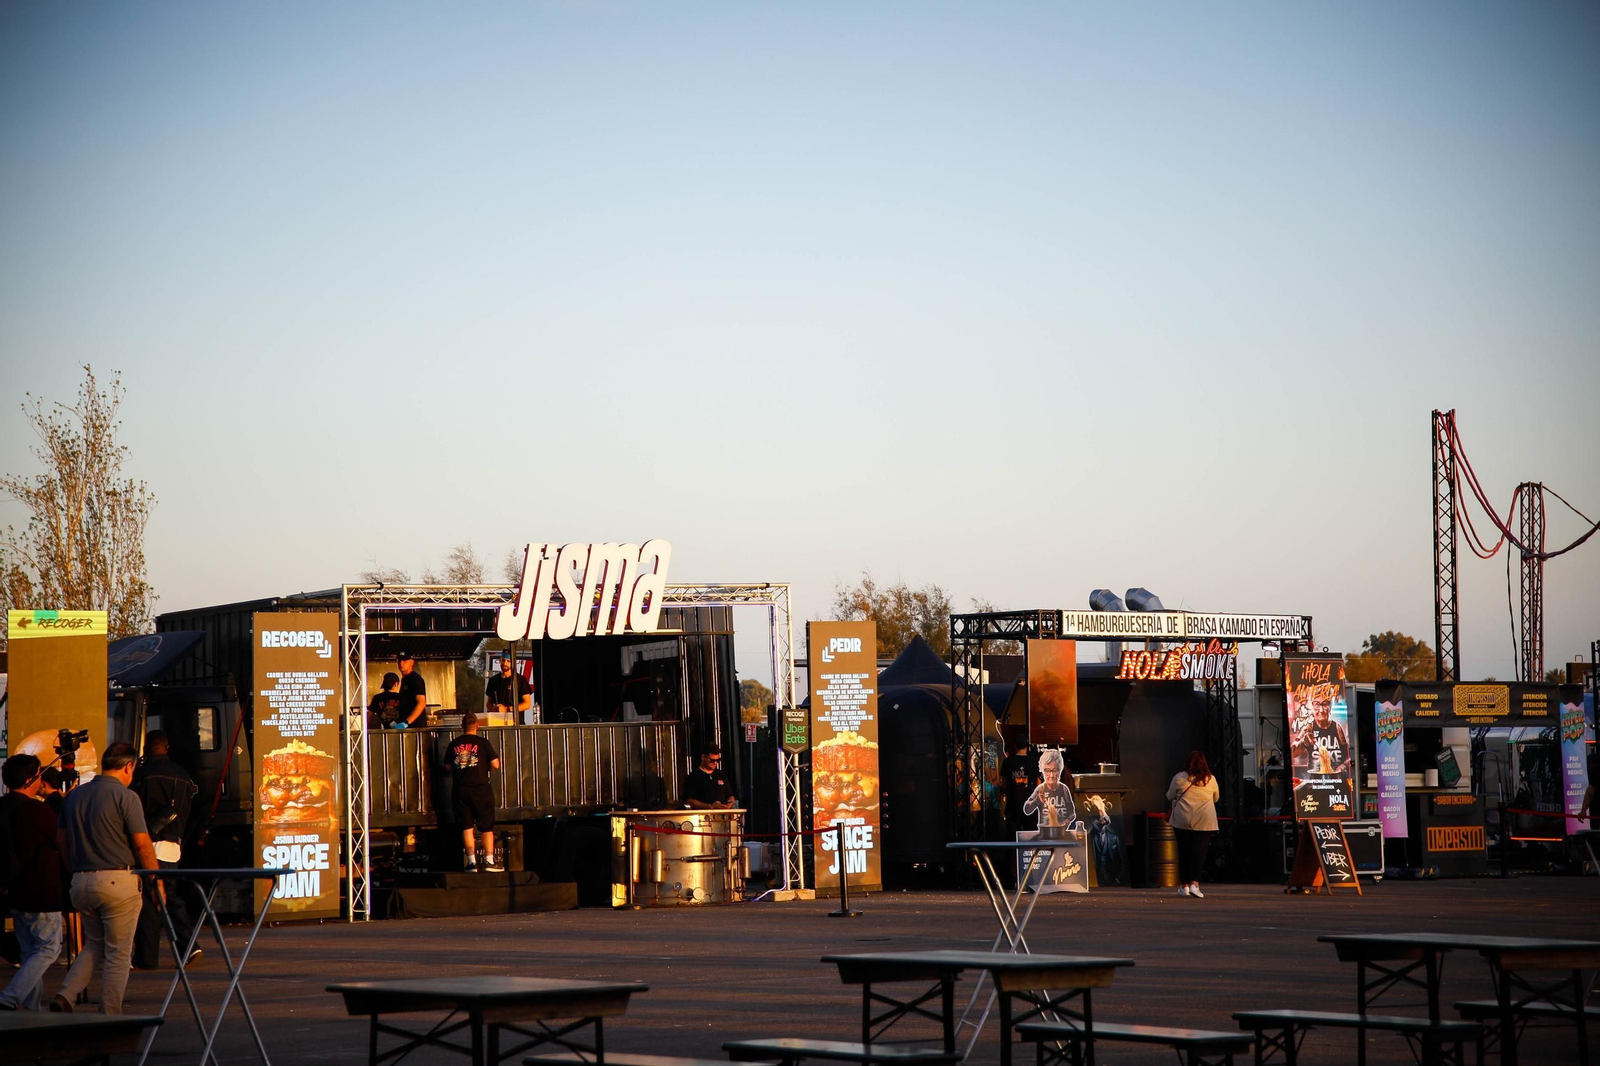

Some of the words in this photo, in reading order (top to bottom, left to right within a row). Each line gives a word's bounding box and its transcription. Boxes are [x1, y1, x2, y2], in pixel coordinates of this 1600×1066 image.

[37, 618, 93, 630] RECOGER
[1167, 616, 1178, 633] DE
[1187, 616, 1217, 634] BRASA
[1220, 618, 1257, 636] KAMADO
[1260, 618, 1269, 636] EN
[1271, 616, 1301, 636] ESPAÑA
[262, 631, 324, 648] RECOGER
[830, 638, 861, 653] PEDIR
[1119, 650, 1175, 680] NOLA
[1180, 653, 1235, 679] SMOKE
[785, 723, 806, 733] Uber
[1378, 724, 1402, 742] POP
[1563, 724, 1584, 742] POP
[785, 734, 806, 743] Eats
[1314, 735, 1340, 750] NOLA
[1044, 796, 1066, 807] NOLA
[1329, 795, 1349, 807] NOLA
[1314, 825, 1340, 840] PEDIR
[262, 844, 329, 870] SPACE
[1323, 852, 1348, 867] UBER
[273, 871, 320, 898] JAM
